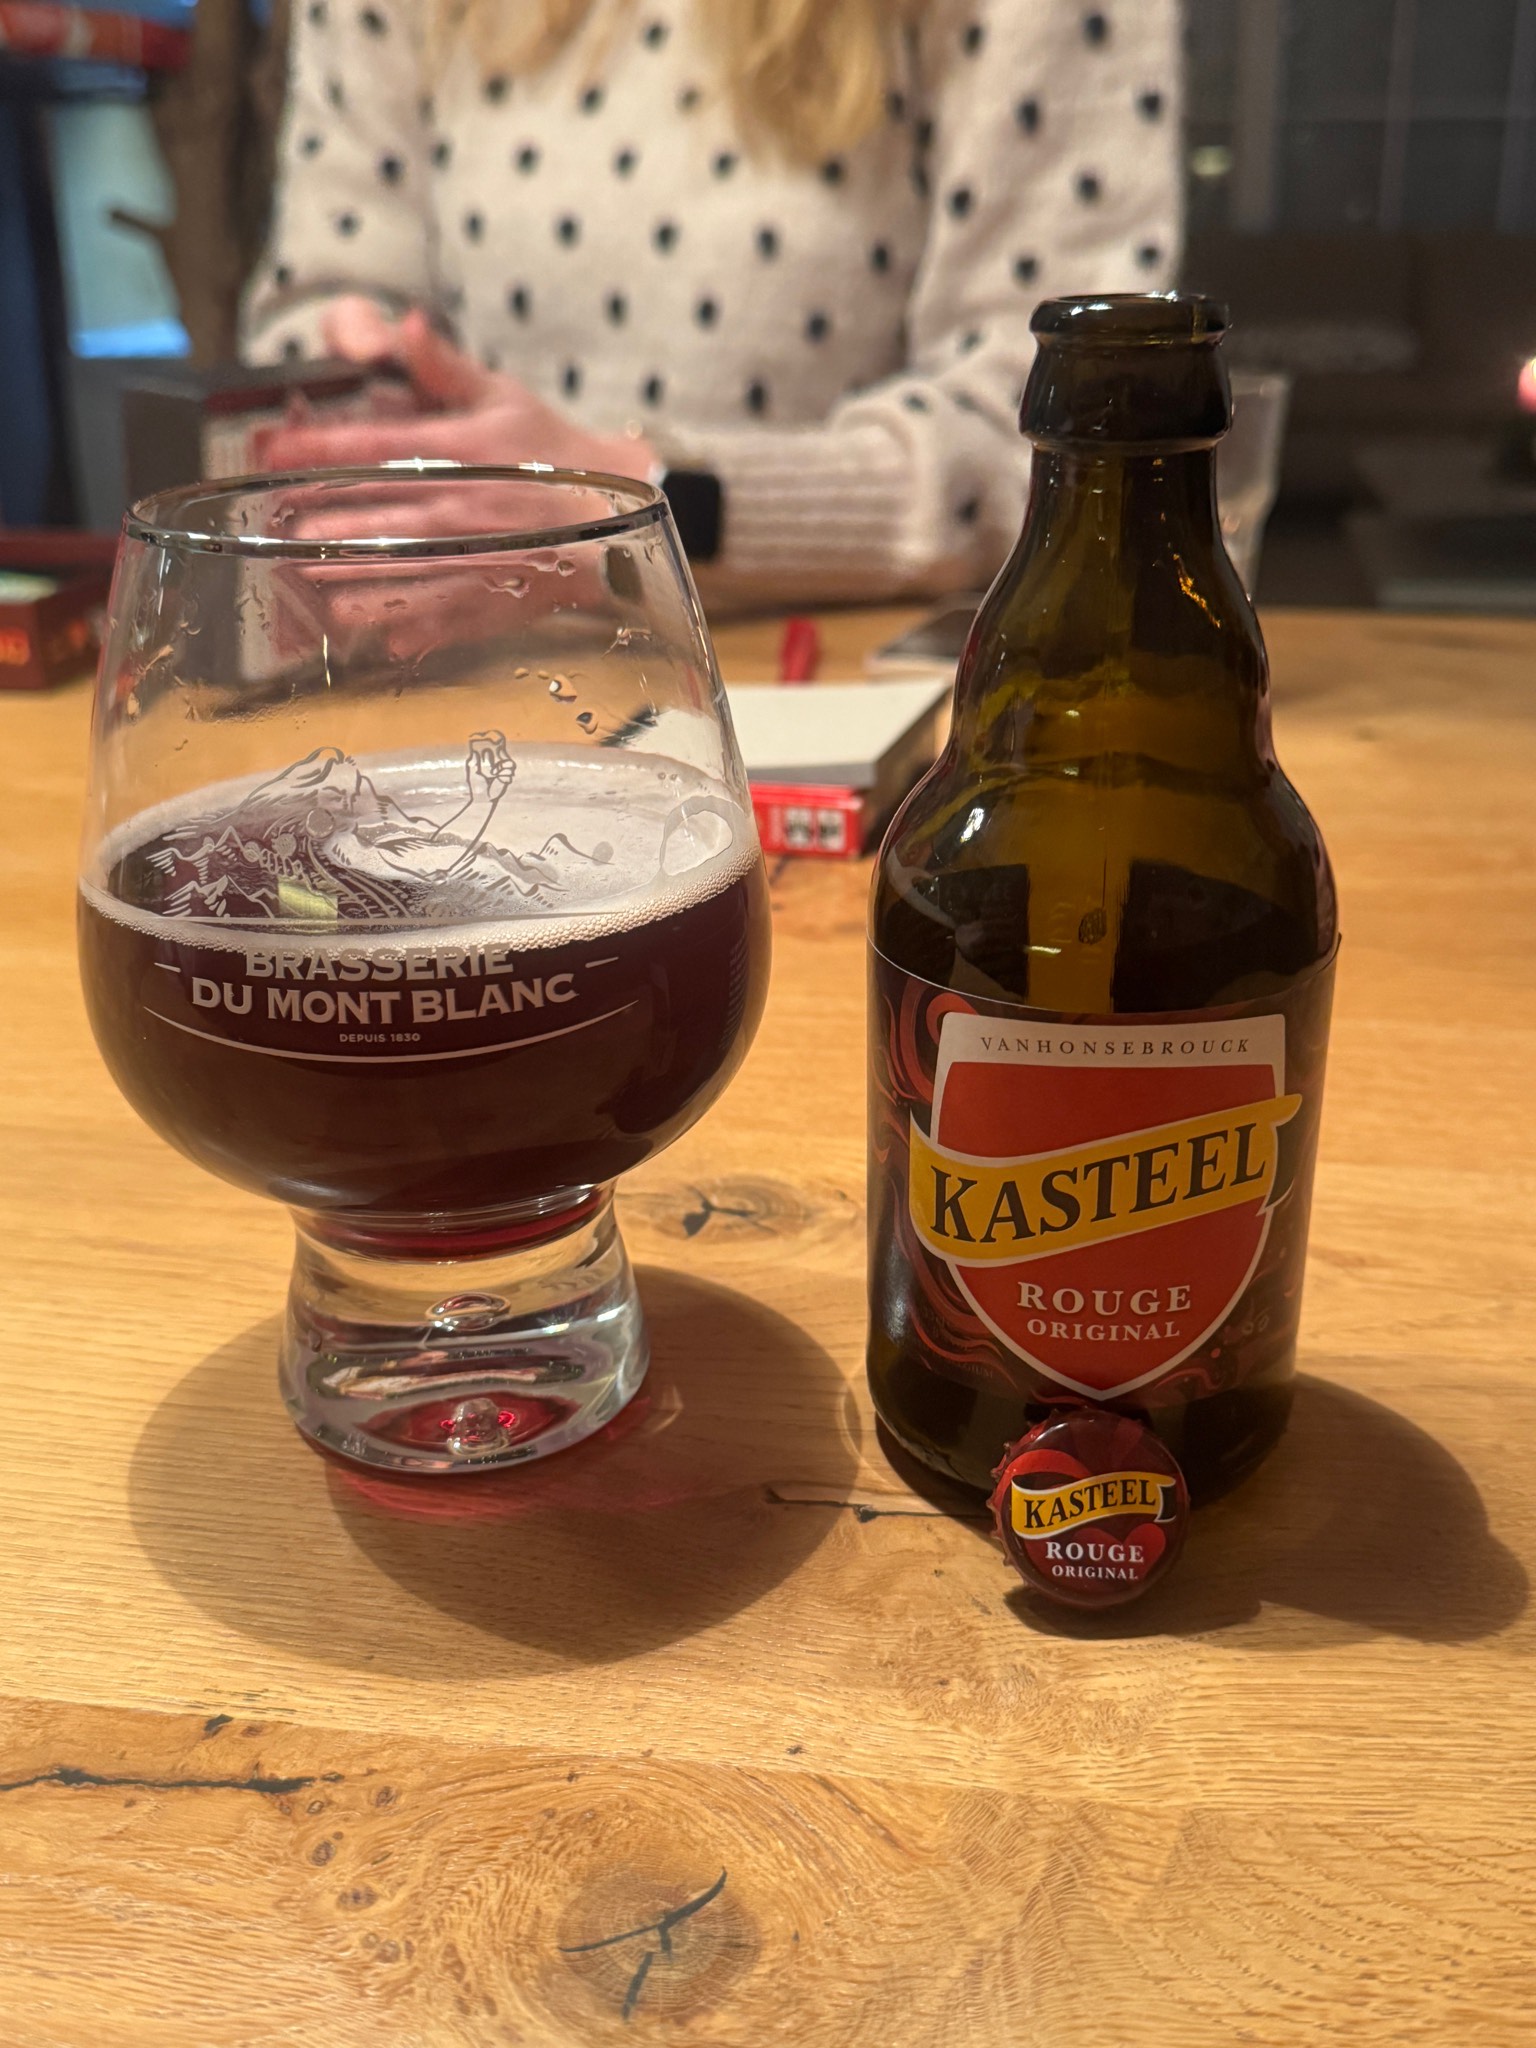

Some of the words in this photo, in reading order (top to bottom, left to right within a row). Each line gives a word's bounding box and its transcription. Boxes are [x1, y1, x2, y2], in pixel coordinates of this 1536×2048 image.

[246, 943, 514, 981] BRASSERIE
[191, 976, 253, 1015] DU
[267, 987, 401, 1025] MONT
[411, 973, 580, 1024] BLANC
[339, 1032, 387, 1043] DEPUIS
[390, 1032, 421, 1043] 1830
[980, 1036, 1250, 1055] VANHONSEBROUCK
[930, 1122, 1267, 1243] KASTEEL
[1017, 1281, 1191, 1316] ROUGE
[1027, 1318, 1180, 1341] ORIGINAL
[1023, 1479, 1157, 1529] KASTEEL
[1045, 1541, 1144, 1563] ROUGE
[1051, 1565, 1139, 1580] ORIGINAL
